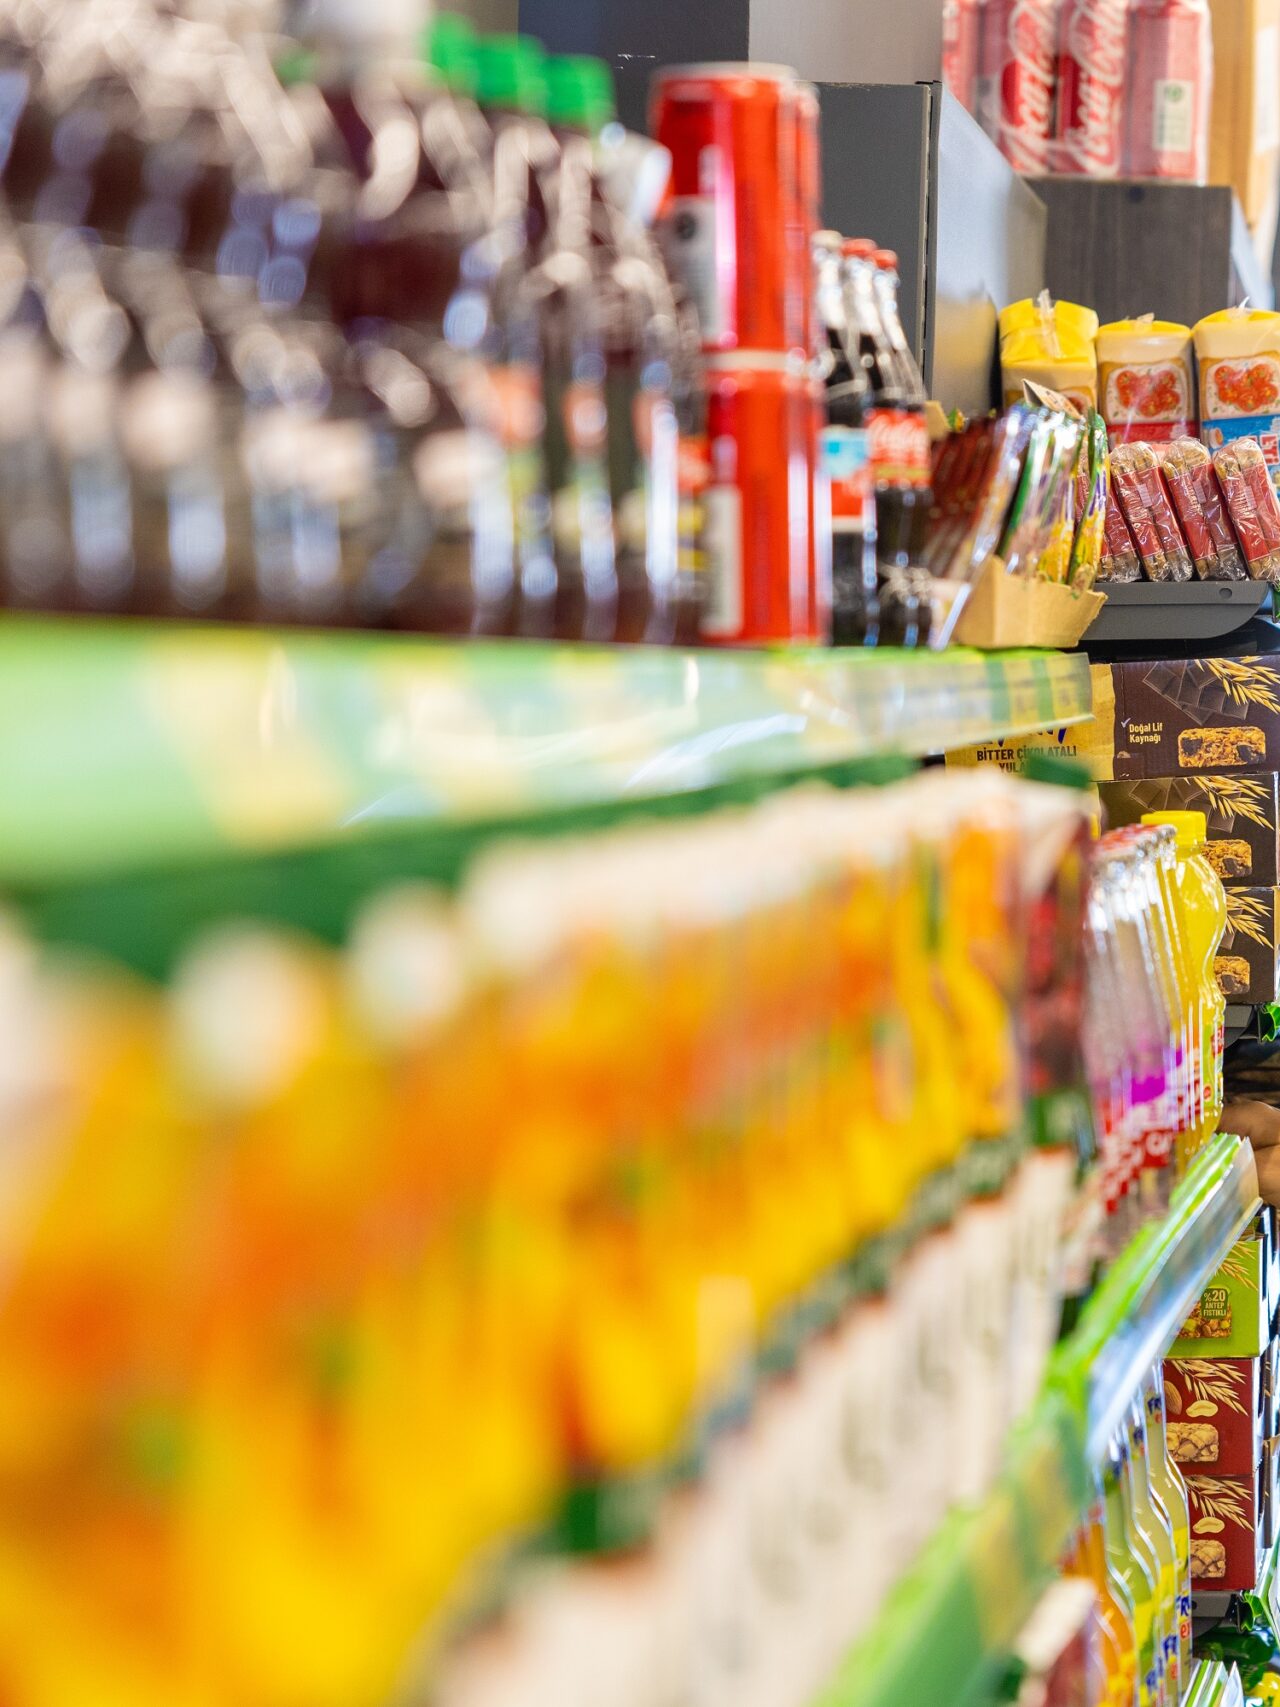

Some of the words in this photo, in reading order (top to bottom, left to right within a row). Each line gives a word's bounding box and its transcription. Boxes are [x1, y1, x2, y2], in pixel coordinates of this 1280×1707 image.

[1129, 722, 1151, 734] Doğal
[1152, 722, 1163, 732] Lif
[1129, 733, 1161, 744] Kaynağı
[977, 747, 1014, 761] BİTTER
[1203, 1290, 1226, 1301] %20
